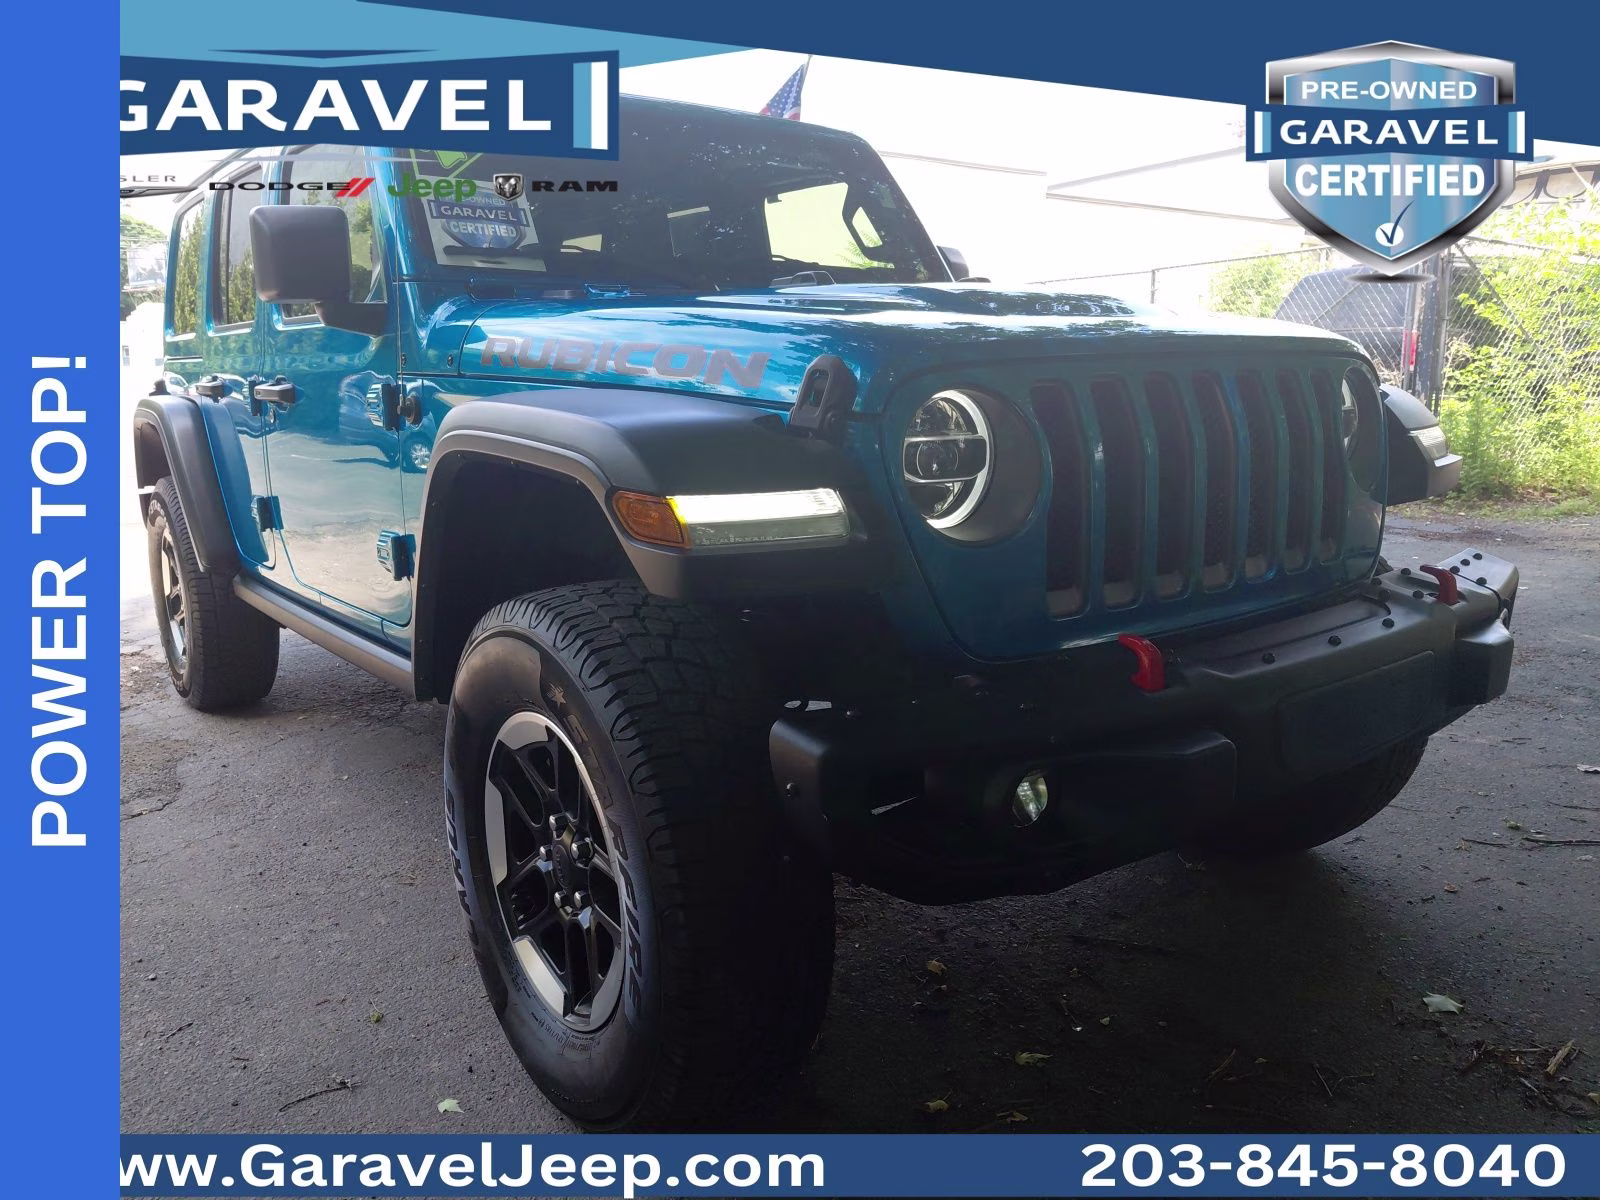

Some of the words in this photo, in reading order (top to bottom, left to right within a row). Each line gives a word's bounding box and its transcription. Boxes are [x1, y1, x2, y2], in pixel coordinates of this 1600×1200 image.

[441, 205, 517, 221] GARAVEL
[449, 221, 517, 237] CERTIFIED
[480, 336, 771, 388] RUBICON
